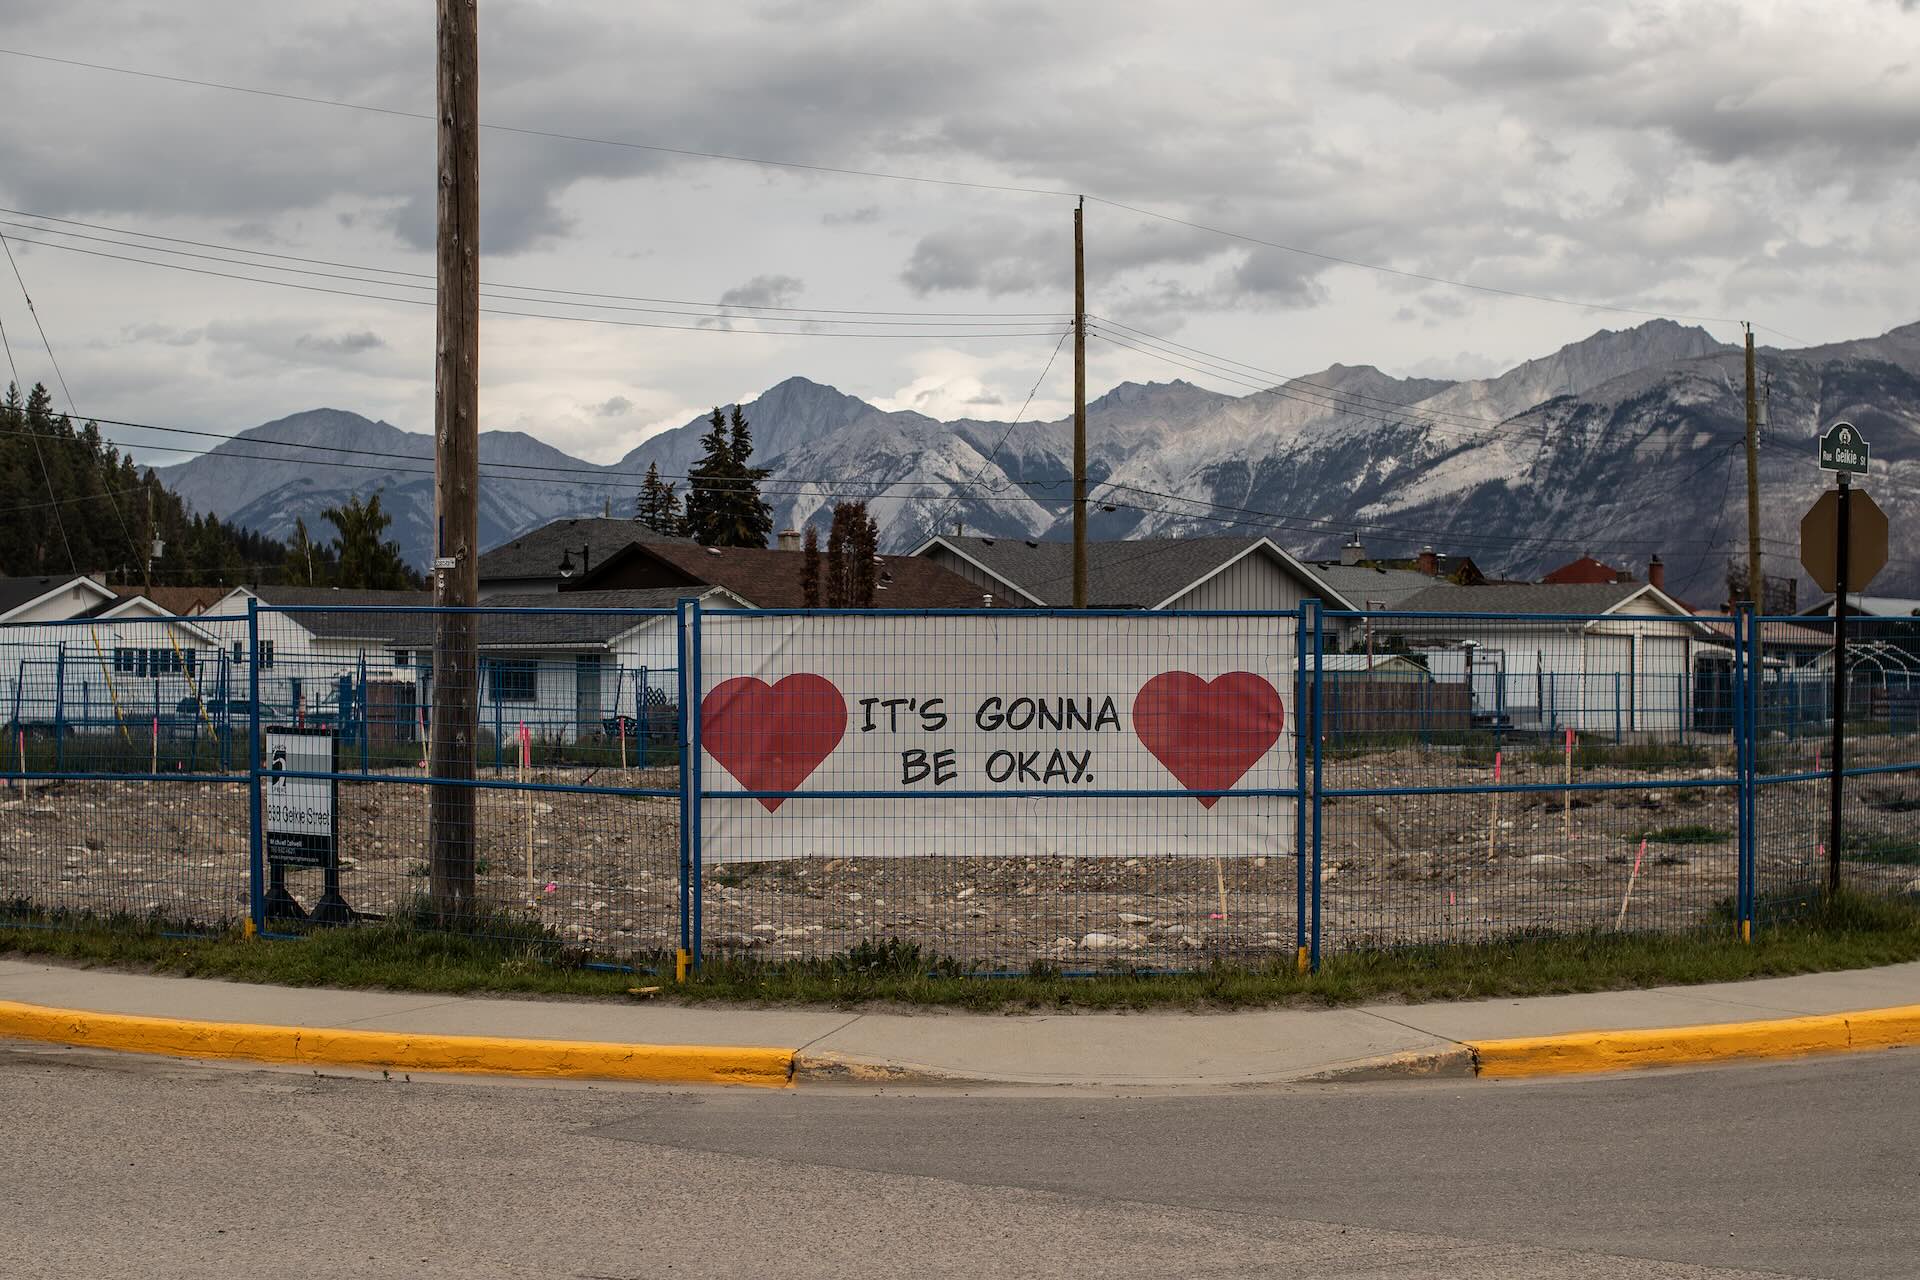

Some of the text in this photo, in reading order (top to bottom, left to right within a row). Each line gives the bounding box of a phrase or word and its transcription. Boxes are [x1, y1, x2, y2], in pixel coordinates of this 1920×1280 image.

[1822, 450, 1833, 461] Rue
[1835, 448, 1857, 465] Geikie
[858, 695, 1122, 734] IT'S GONNA
[900, 747, 1095, 786] BE OKAY.
[282, 805, 306, 825] Geikie
[306, 807, 330, 826] Street
